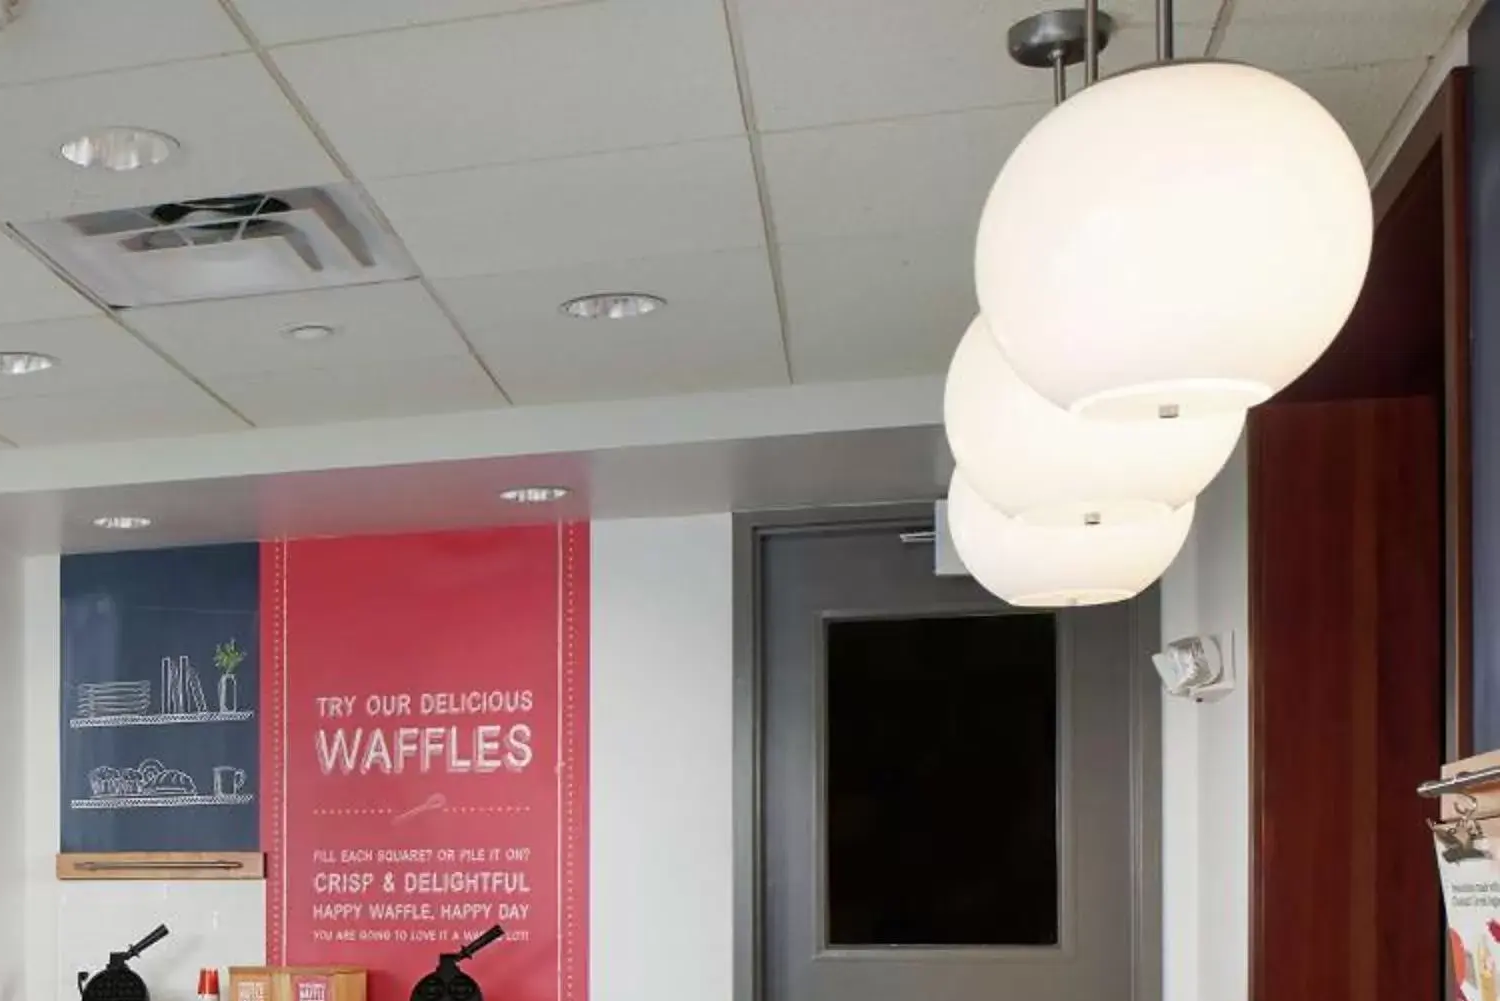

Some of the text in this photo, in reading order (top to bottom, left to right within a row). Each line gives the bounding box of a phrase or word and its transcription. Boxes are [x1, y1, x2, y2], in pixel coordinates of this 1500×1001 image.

[315, 690, 533, 717] TRY OUR DELICIOUS
[315, 723, 534, 775] WAFFLES
[313, 848, 531, 863] FILL EACH SQUARE? OR PILE IT ON?
[314, 870, 531, 893] CRISP & DELIGHTFUL
[313, 904, 363, 920] HAPPY
[441, 903, 492, 920] HAPPY
[498, 903, 530, 920] DAY
[313, 930, 333, 941] YOU
[336, 930, 357, 941] ARE
[359, 930, 391, 941] GOING
[394, 930, 408, 941] TO
[410, 930, 437, 941] LOVE
